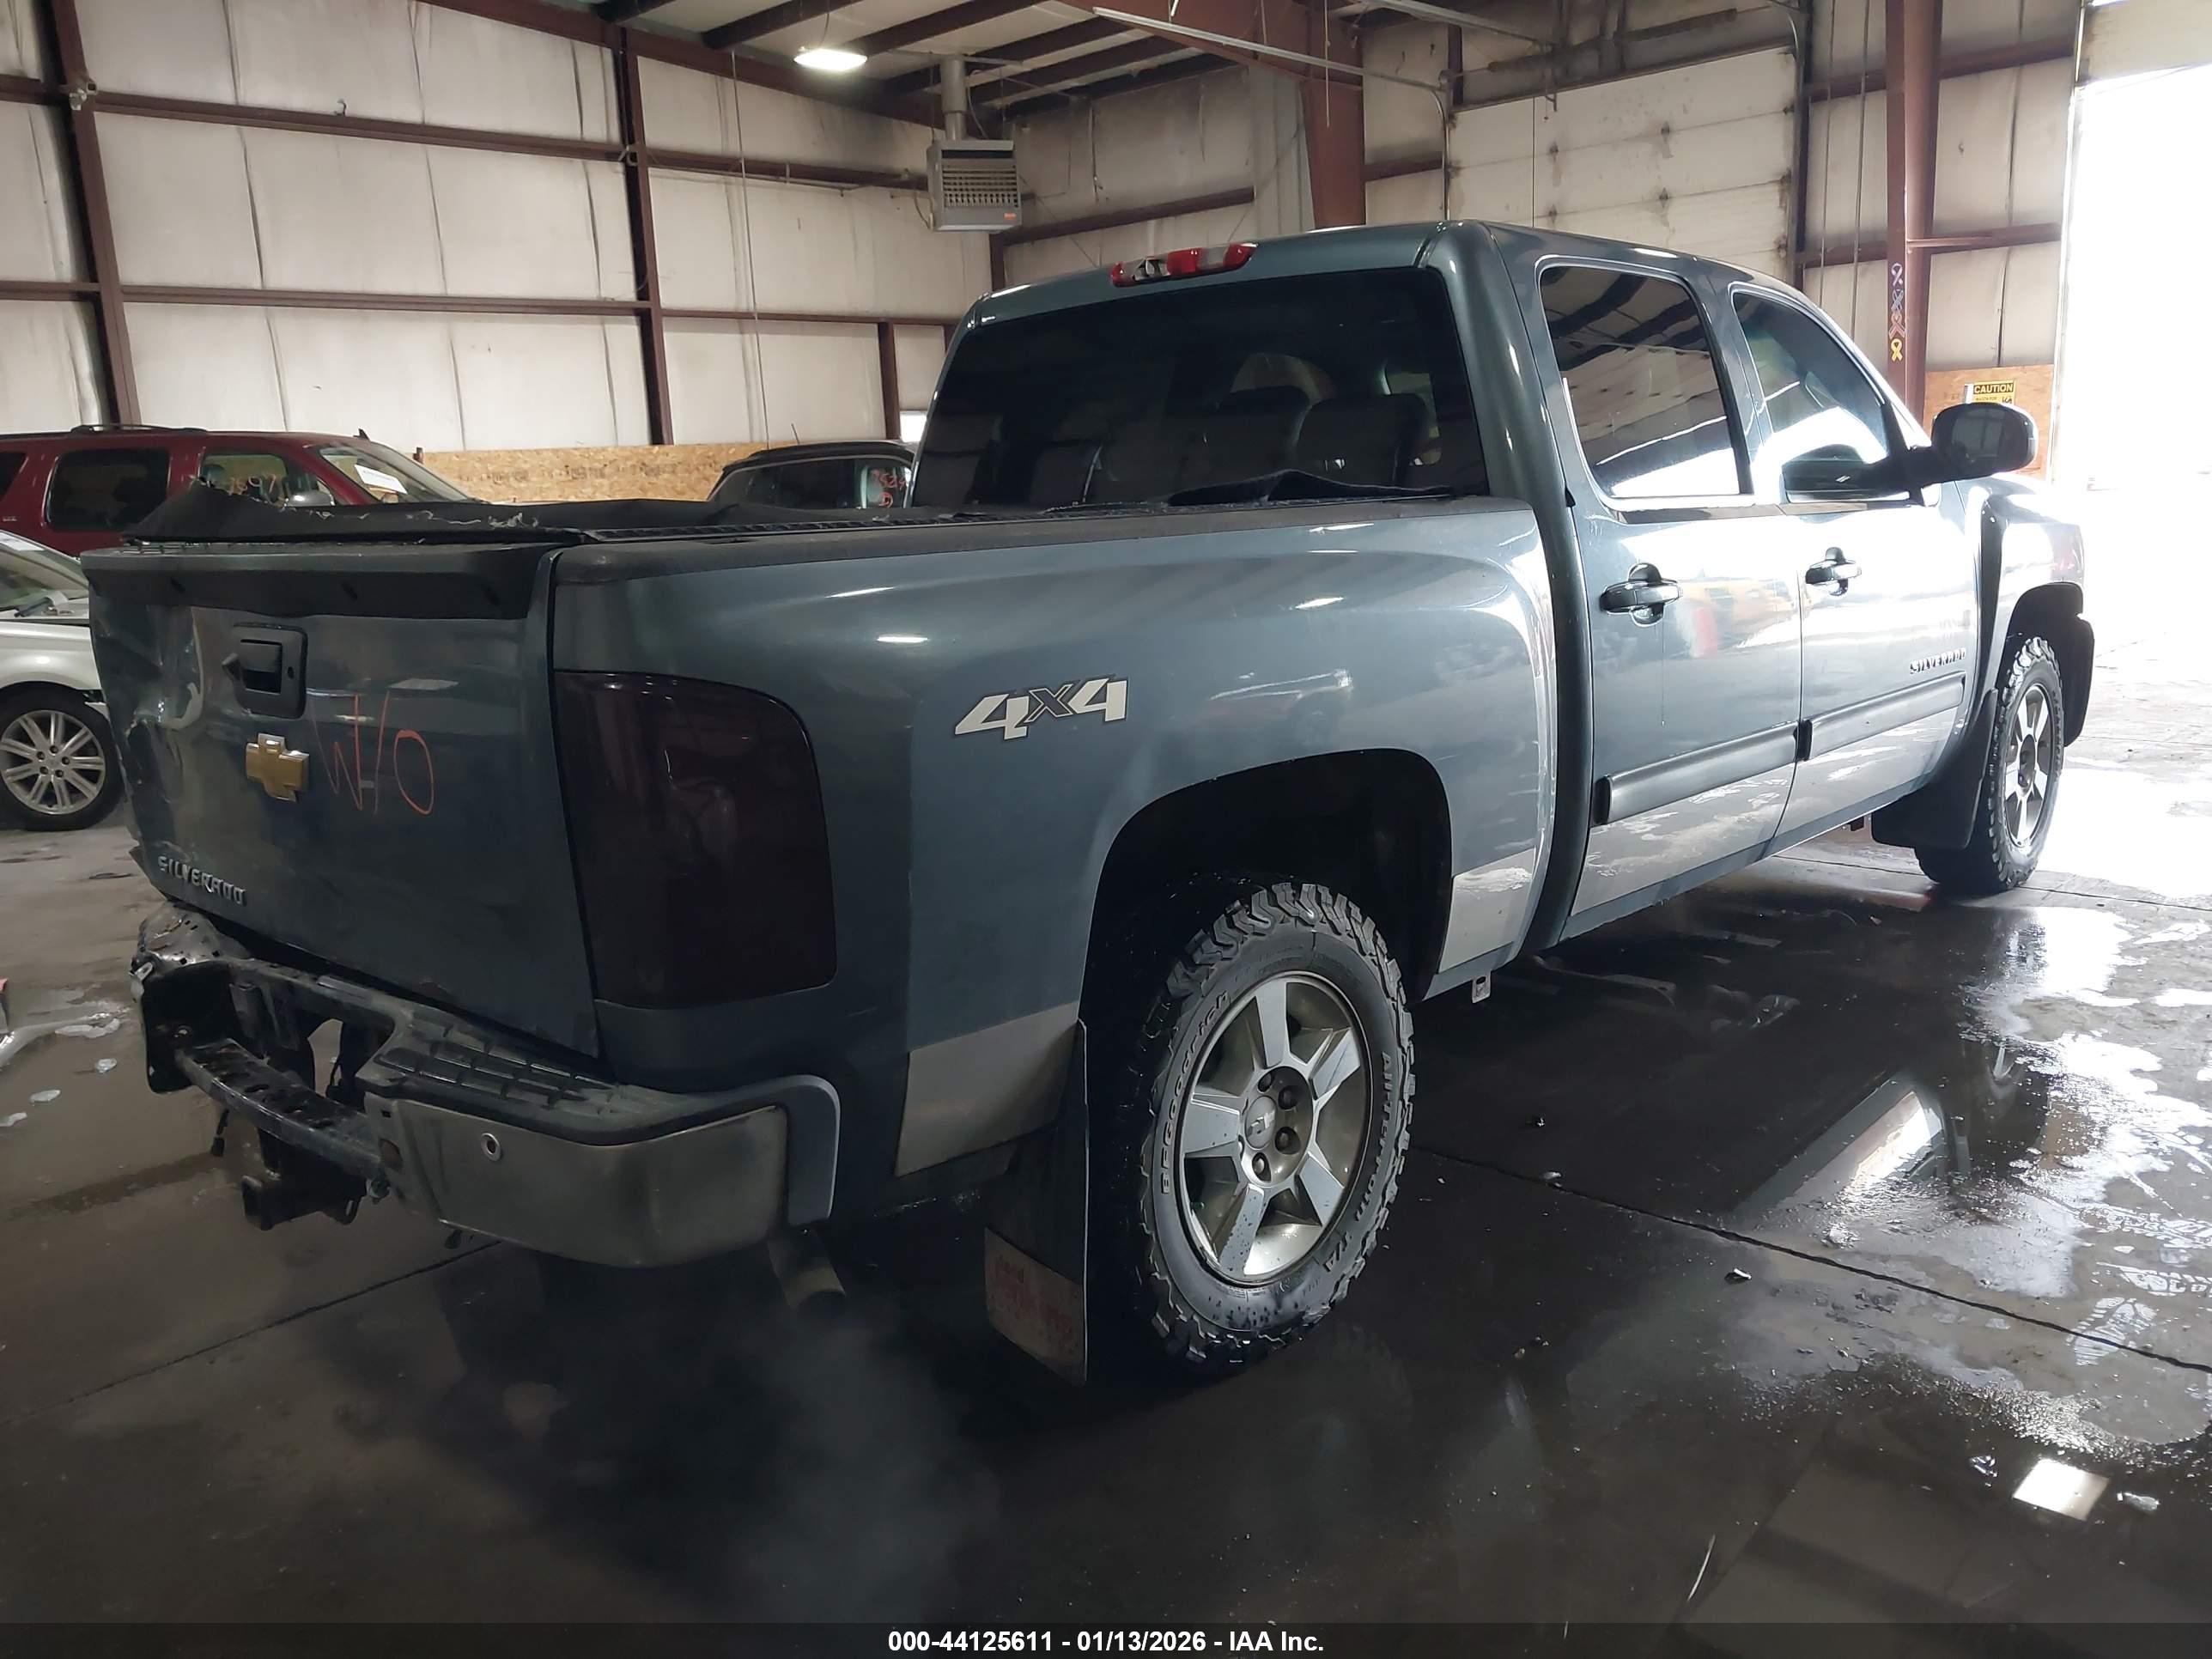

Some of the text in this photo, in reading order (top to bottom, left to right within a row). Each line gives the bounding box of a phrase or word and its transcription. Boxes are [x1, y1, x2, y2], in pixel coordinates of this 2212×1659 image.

[1974, 384, 2014, 394] CAUTION
[157, 855, 247, 906] SILVERADO
[1160, 990, 1231, 1195] BFGoodrich
